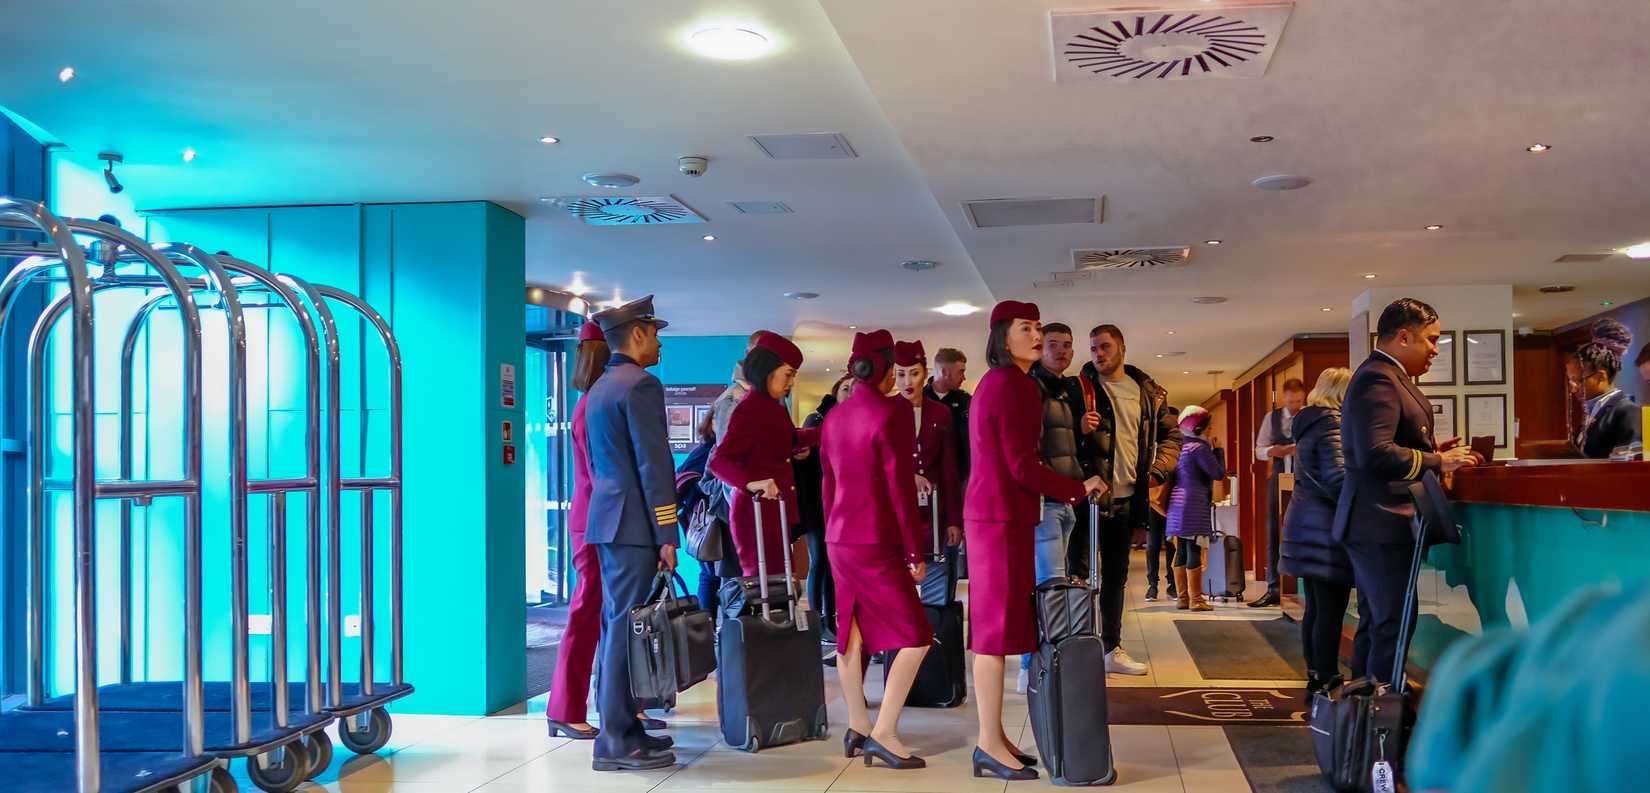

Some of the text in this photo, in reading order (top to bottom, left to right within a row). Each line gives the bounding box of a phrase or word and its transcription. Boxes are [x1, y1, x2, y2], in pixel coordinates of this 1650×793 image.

[1201, 692, 1253, 717] CLUB
[1247, 698, 1274, 709] THE
[1379, 768, 1388, 792] CREW
